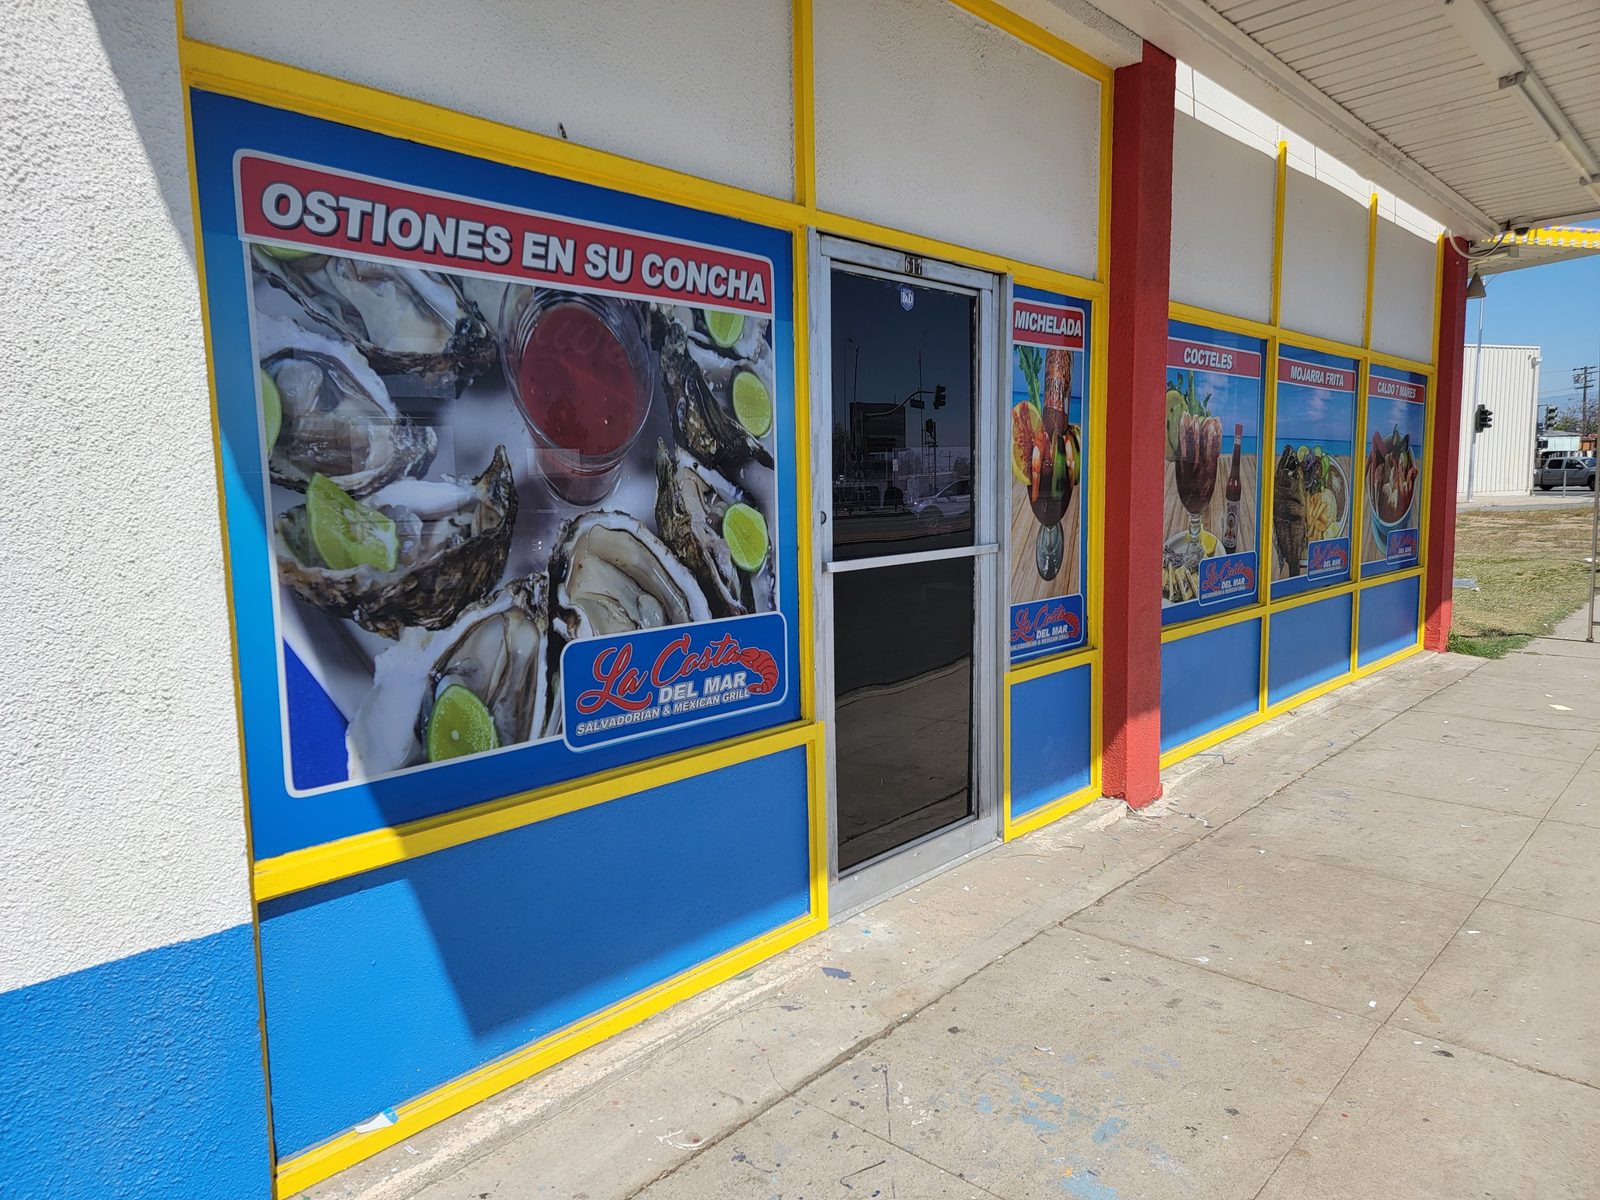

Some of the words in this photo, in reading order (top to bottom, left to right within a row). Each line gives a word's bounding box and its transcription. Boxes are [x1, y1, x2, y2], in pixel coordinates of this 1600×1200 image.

[261, 182, 511, 265] OSTIONES
[521, 231, 575, 274] EN
[585, 243, 633, 283] SU
[641, 254, 766, 304] CONCHA
[905, 256, 922, 275] 617
[1014, 309, 1082, 337] MICHELADA
[1183, 347, 1233, 370] COCTELES
[1290, 365, 1325, 384] MOJARRA
[1325, 372, 1344, 387] FRITA
[1377, 381, 1395, 396] CALDO
[1395, 384, 1400, 396] 7
[1400, 385, 1417, 399] MARES
[1221, 580, 1233, 589] DEL
[1232, 577, 1246, 587] MAR
[1010, 608, 1035, 642] La
[1034, 604, 1067, 630] Costa
[1036, 628, 1051, 639] DEL
[1052, 624, 1068, 636] MAR
[576, 643, 653, 714] La
[651, 633, 742, 687] Costa
[657, 681, 699, 705] DEL
[704, 671, 748, 695] MAR
[575, 708, 661, 736] SALVADORIAN
[661, 705, 672, 718] &
[673, 695, 721, 713] MEXICAN
[722, 690, 751, 702] GRILL
